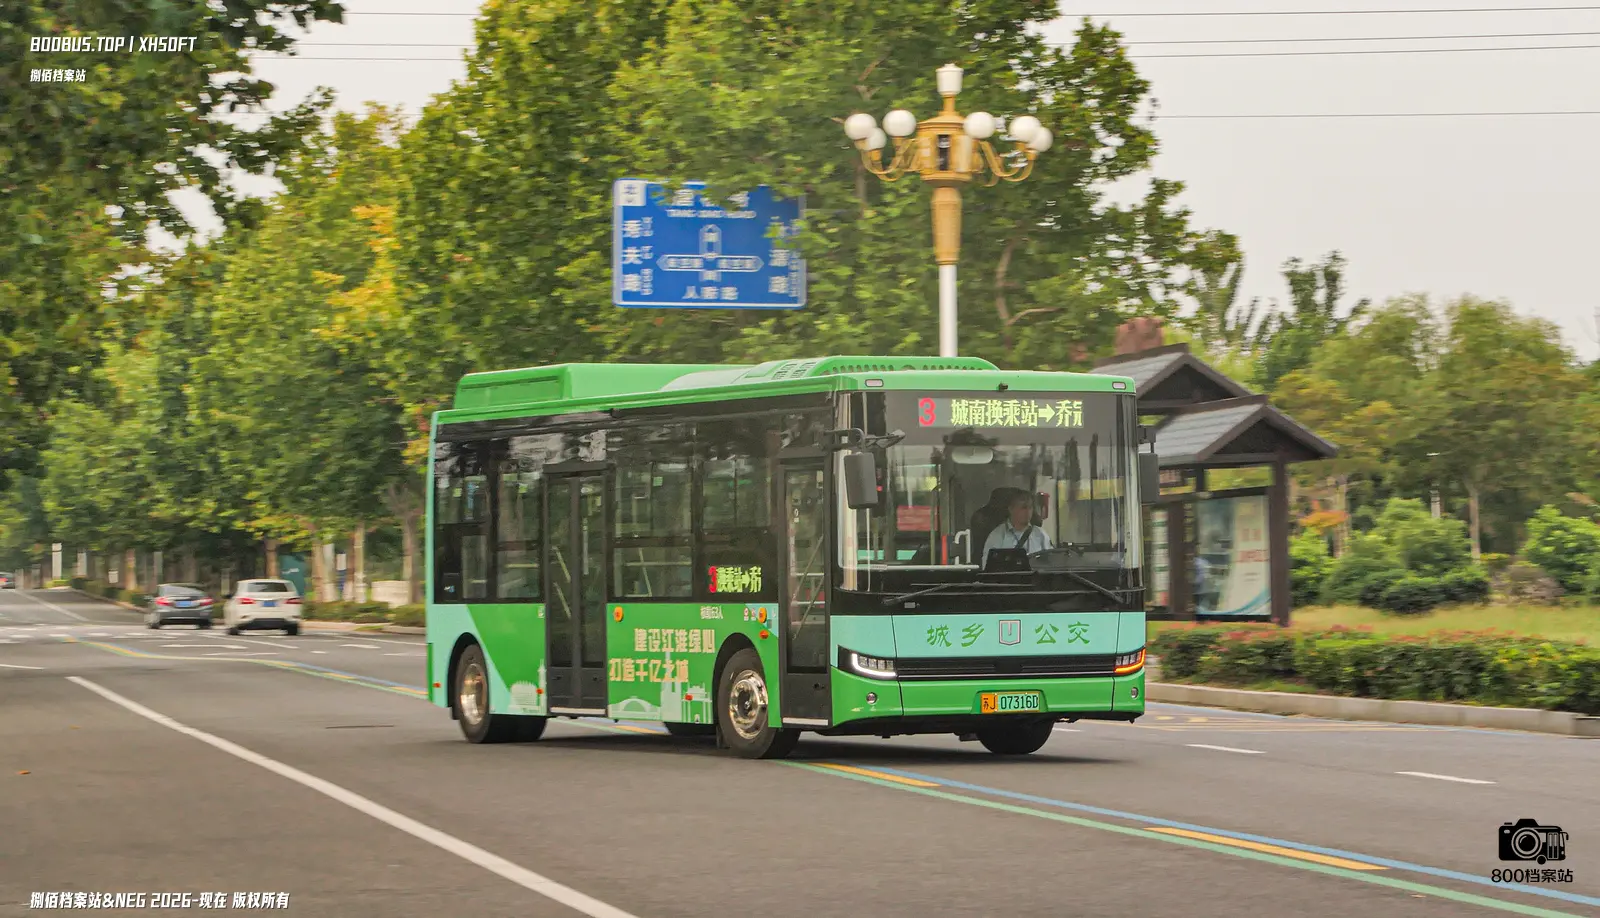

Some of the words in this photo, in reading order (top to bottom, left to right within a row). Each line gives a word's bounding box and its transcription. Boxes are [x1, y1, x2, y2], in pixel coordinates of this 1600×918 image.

[919, 398, 936, 426] 3
[951, 399, 1038, 427] 城南换乘站
[708, 566, 717, 593] 3
[927, 623, 984, 646] 城乡
[1035, 622, 1090, 645] 公交
